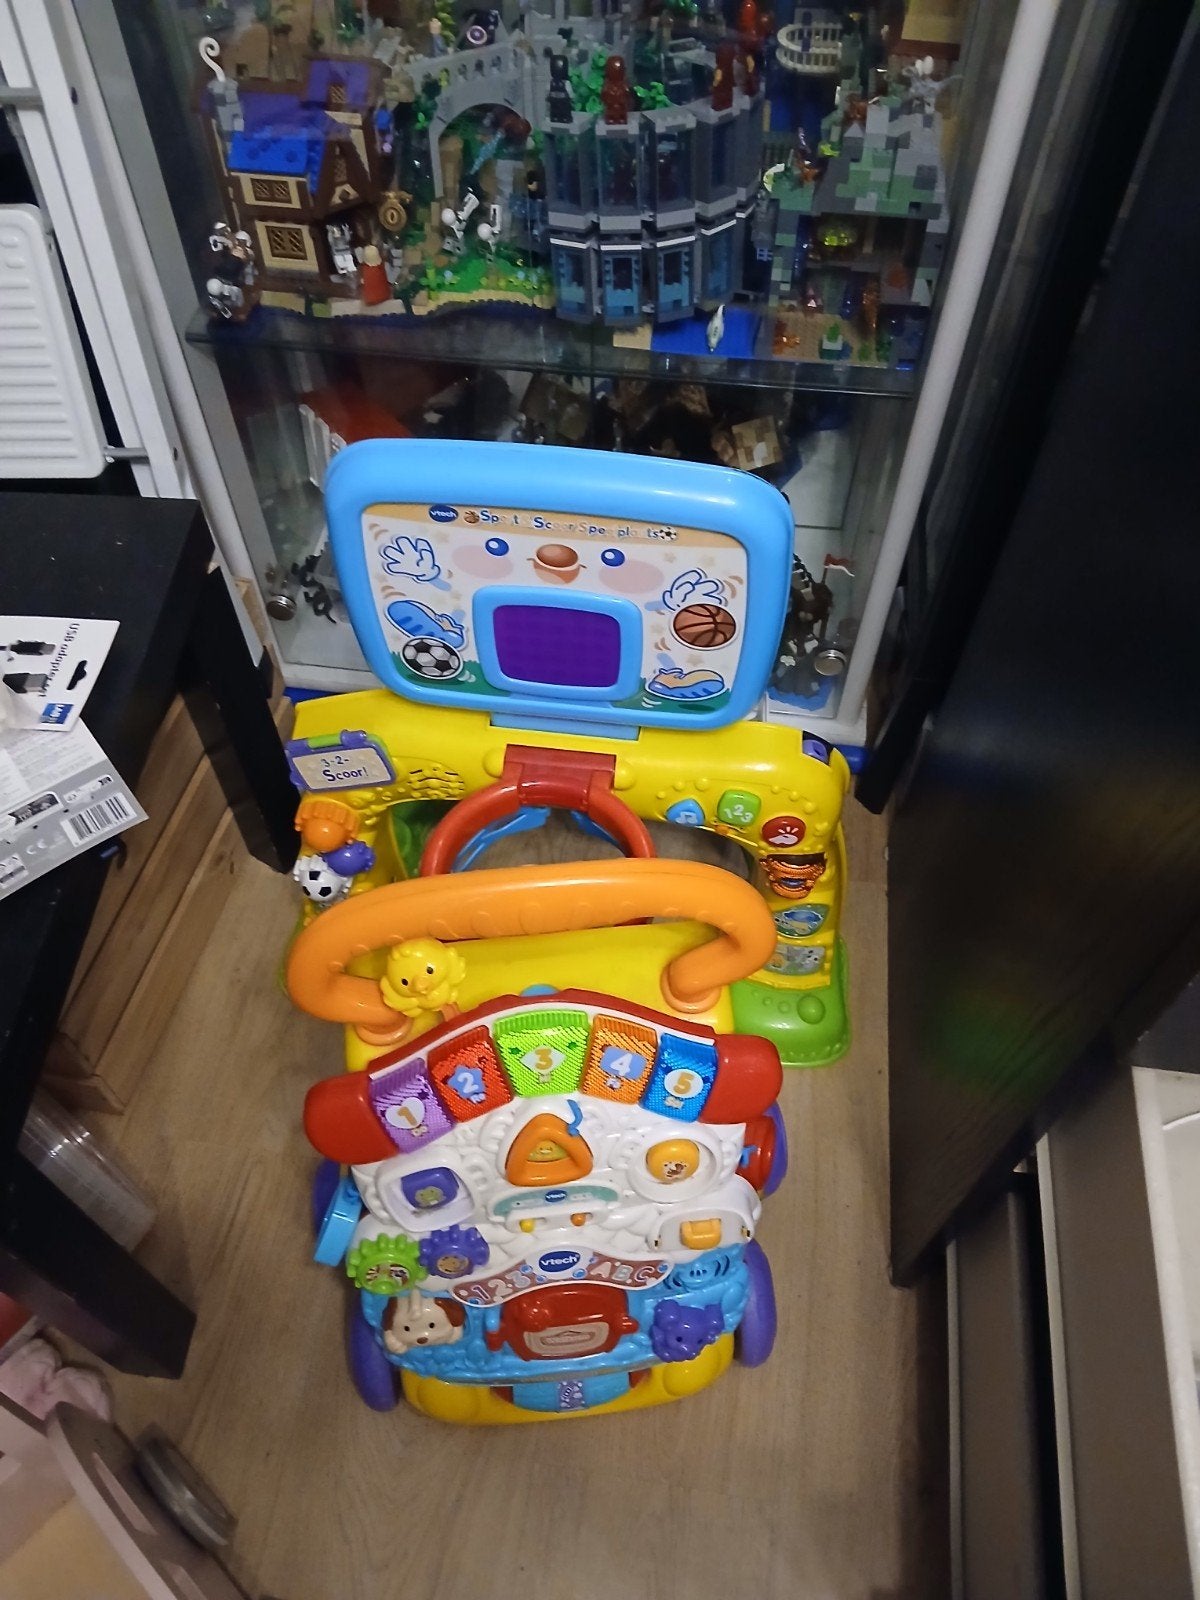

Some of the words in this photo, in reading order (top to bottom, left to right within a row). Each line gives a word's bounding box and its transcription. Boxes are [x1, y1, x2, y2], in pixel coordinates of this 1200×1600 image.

[64, 623, 80, 642] USB
[322, 766, 369, 782] Scoor!
[533, 1048, 554, 1071] 3
[610, 1052, 633, 1077] 4
[457, 1072, 479, 1094] 2
[673, 1072, 697, 1095] 5
[396, 1106, 417, 1126] 1
